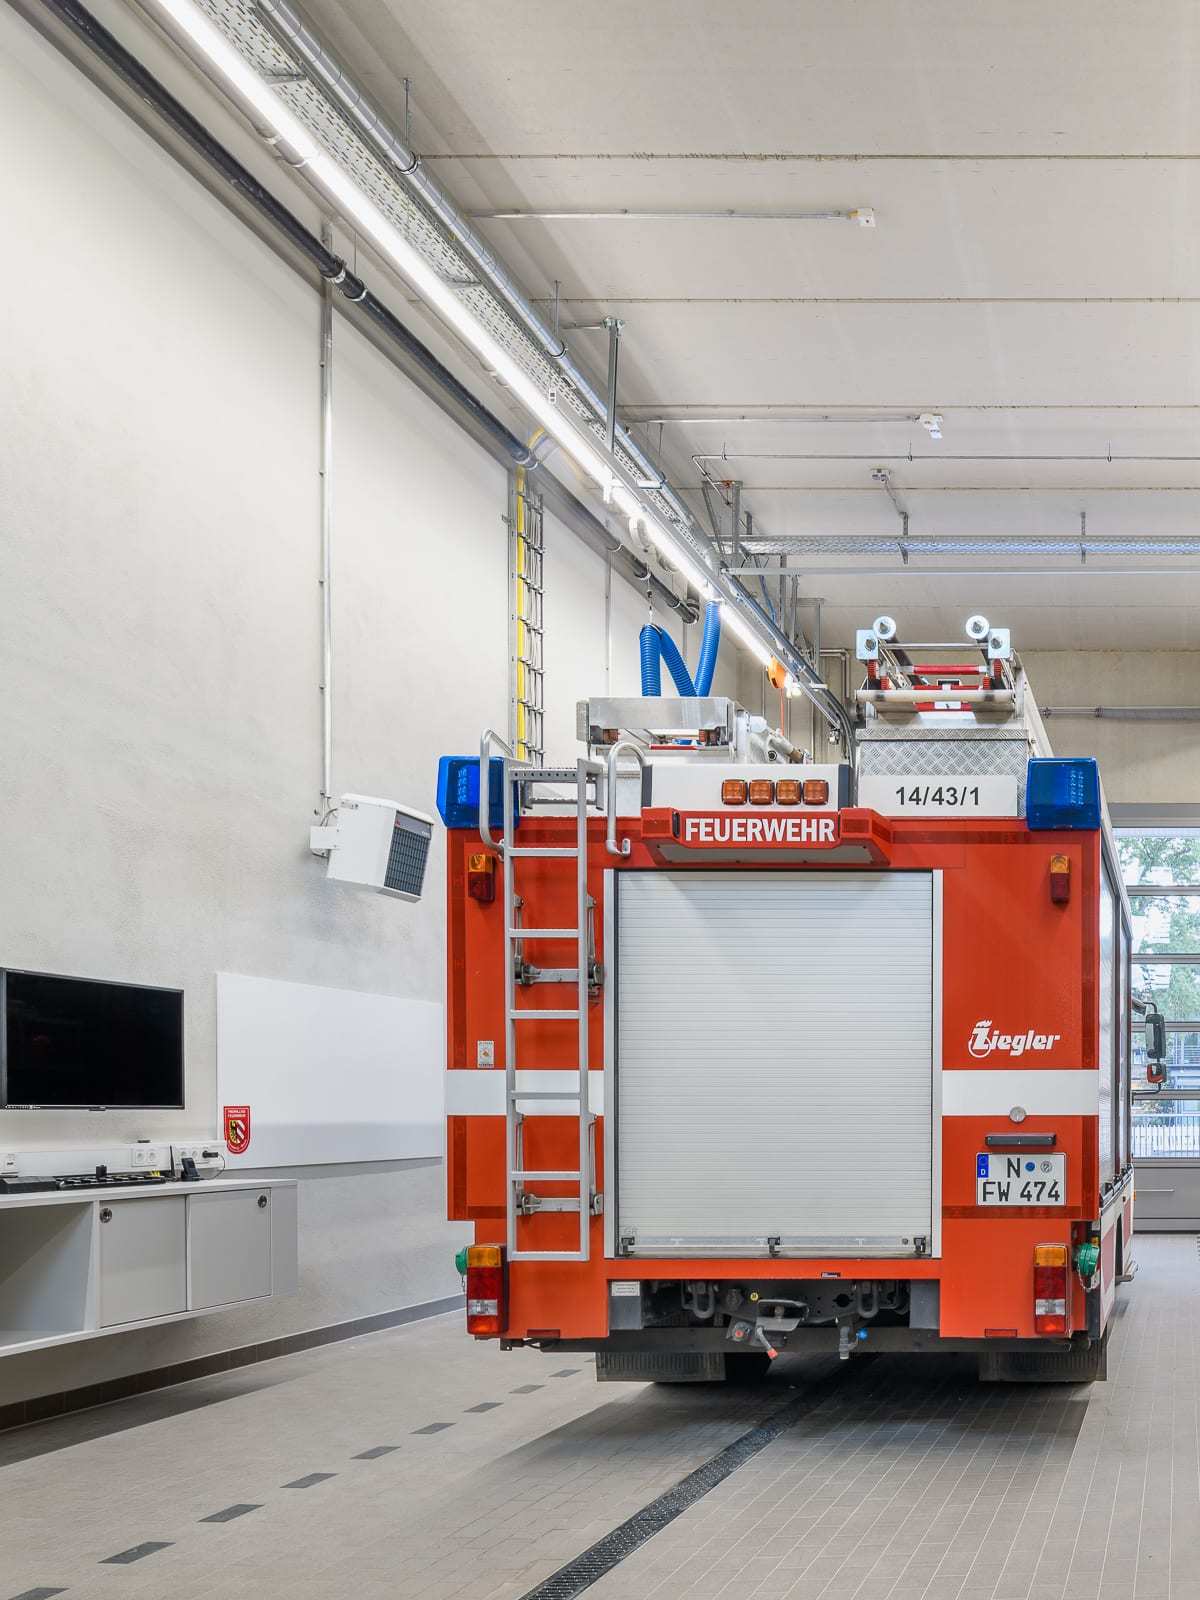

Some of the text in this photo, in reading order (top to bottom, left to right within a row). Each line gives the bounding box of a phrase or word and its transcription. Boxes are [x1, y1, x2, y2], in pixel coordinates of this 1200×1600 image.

[895, 786, 980, 806] 14/43/1
[685, 818, 835, 842] FEUERWEHR
[968, 1020, 1061, 1058] Ziegler
[980, 1168, 986, 1176] D
[1007, 1157, 1021, 1178] N
[982, 1181, 1060, 1202] FW 474
